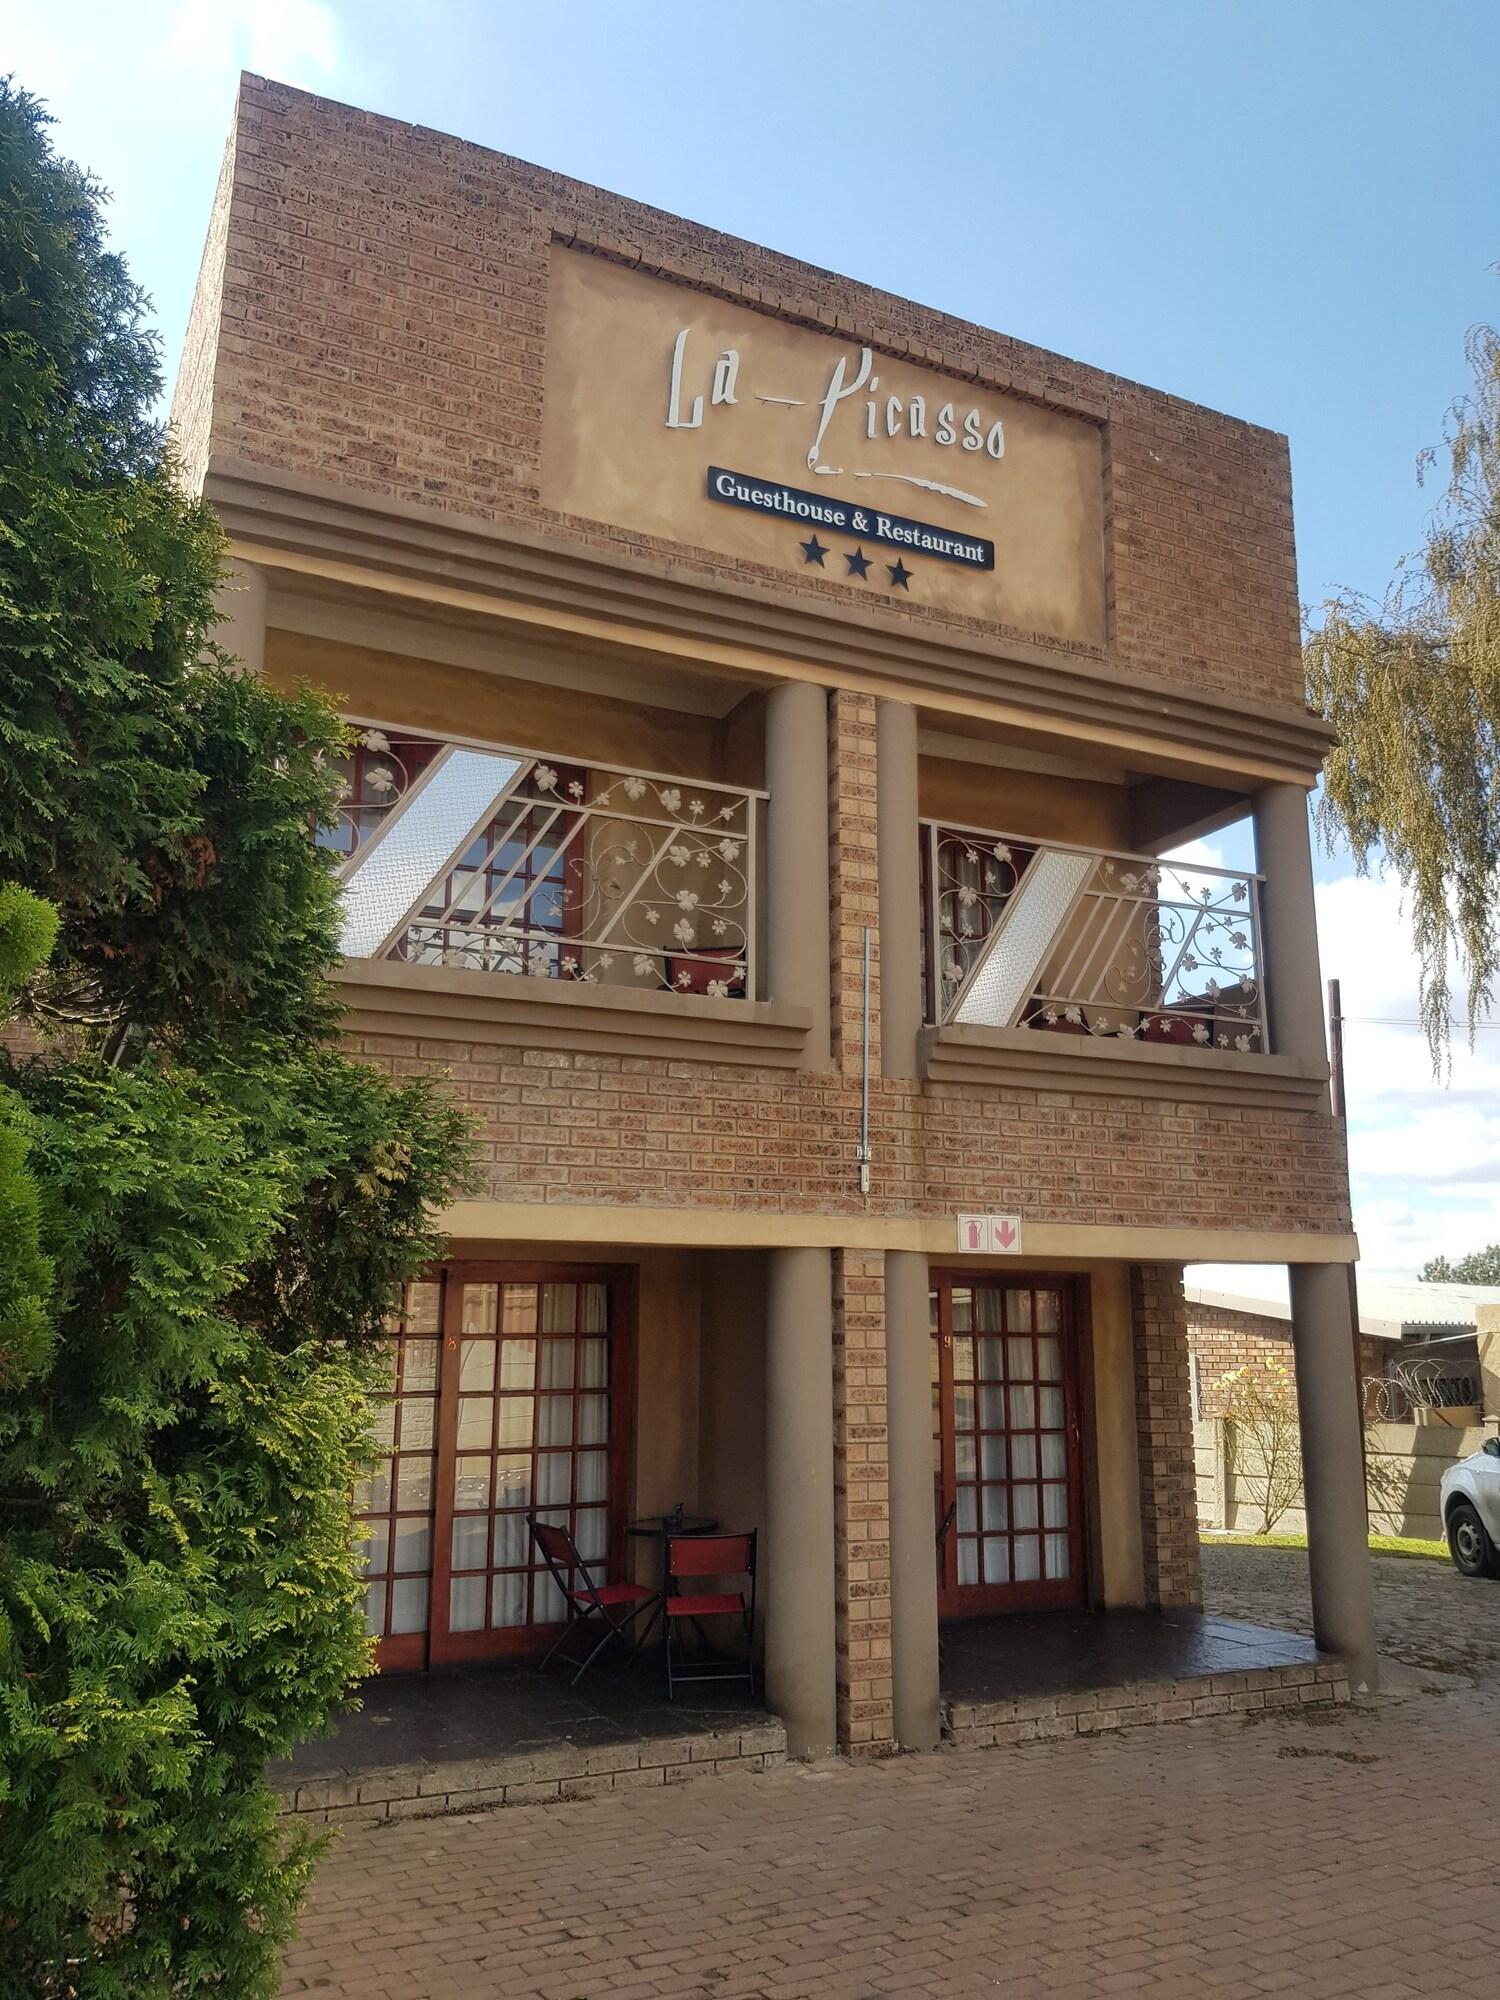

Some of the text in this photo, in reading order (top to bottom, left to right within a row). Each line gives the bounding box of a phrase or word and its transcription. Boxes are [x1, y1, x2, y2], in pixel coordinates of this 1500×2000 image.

[665, 328, 1006, 472] La Picasso
[716, 475, 985, 562] Guesthouse & Restaurant
[448, 1335, 457, 1351] 8
[944, 1335, 951, 1349] 9
